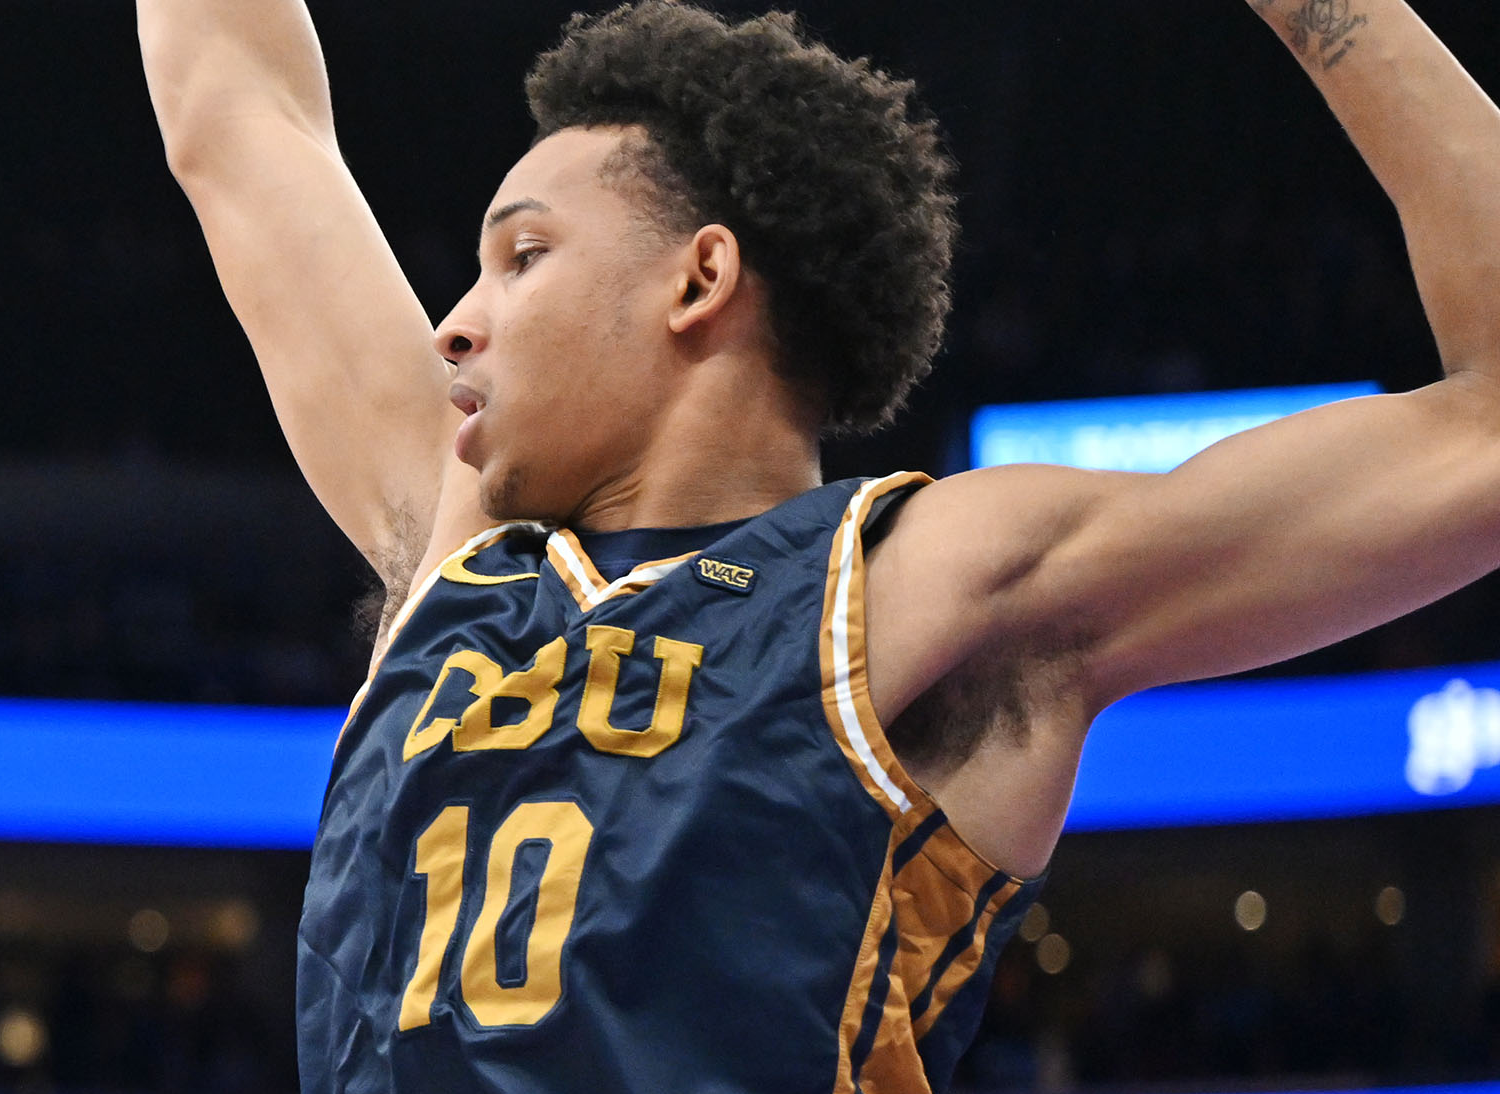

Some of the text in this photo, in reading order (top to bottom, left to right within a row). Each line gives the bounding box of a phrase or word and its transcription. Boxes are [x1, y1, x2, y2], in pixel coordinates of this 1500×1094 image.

[698, 559, 754, 587] WAC
[402, 624, 706, 763] CBU
[398, 801, 595, 1032] 10
